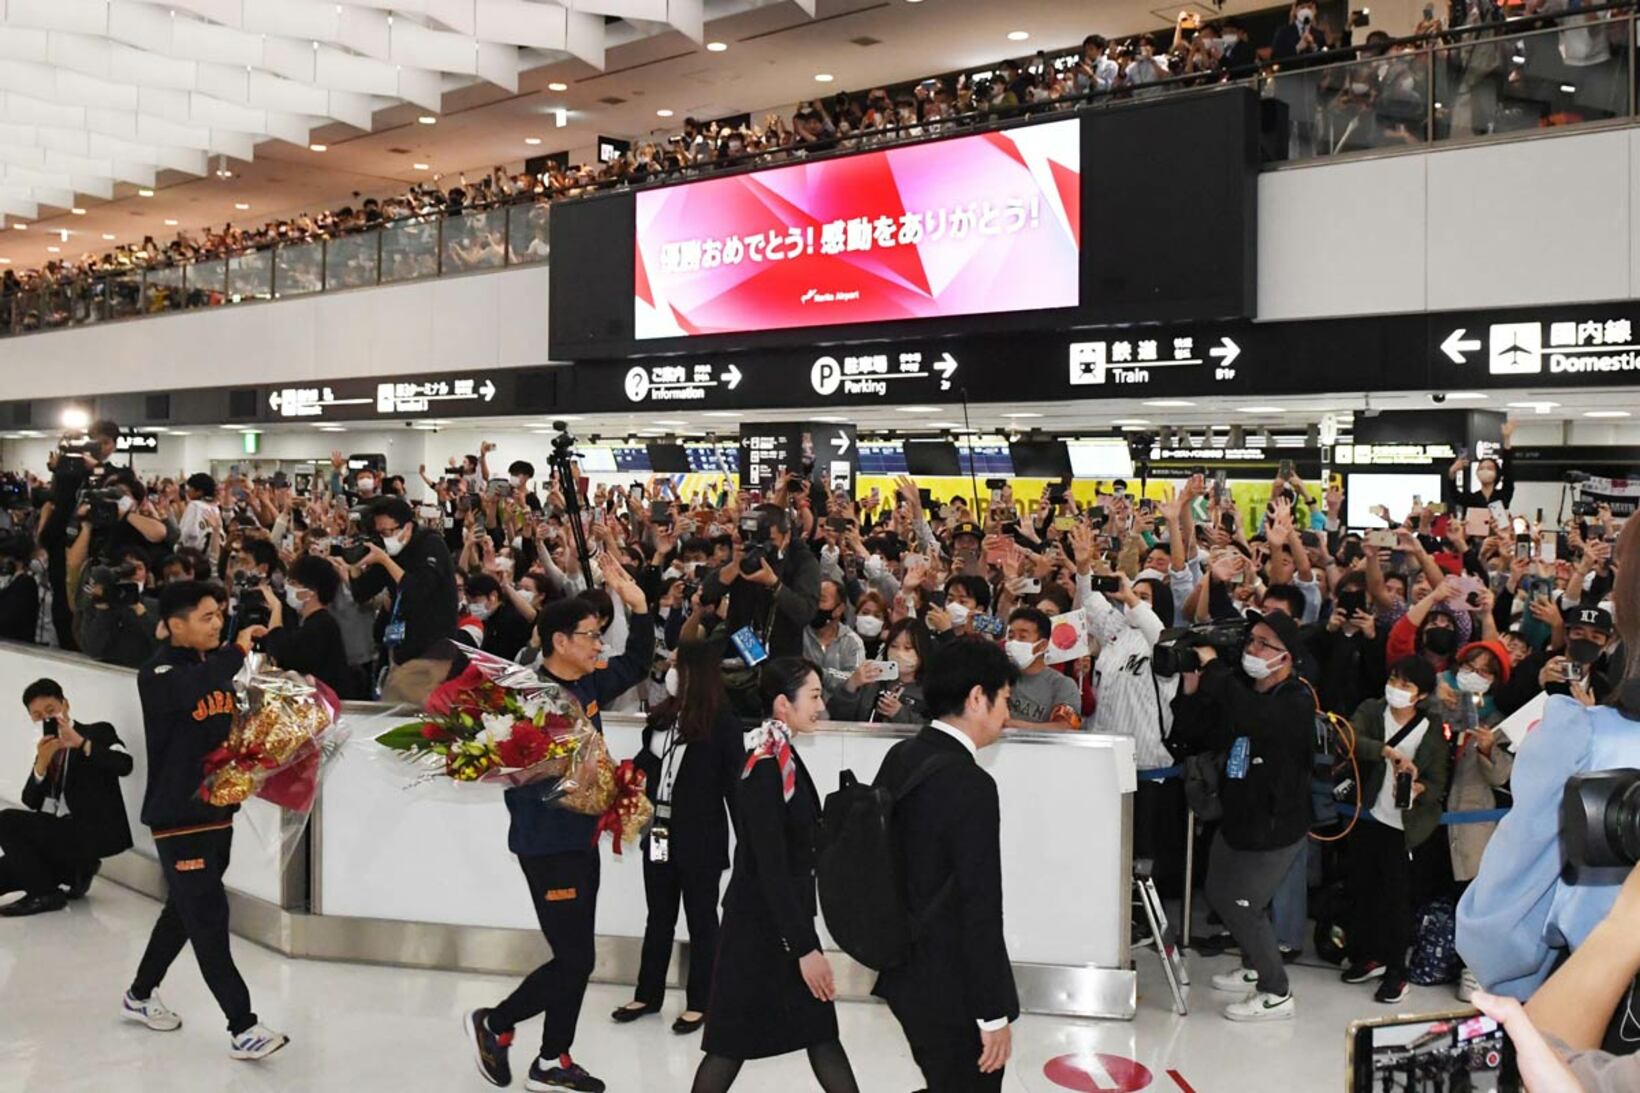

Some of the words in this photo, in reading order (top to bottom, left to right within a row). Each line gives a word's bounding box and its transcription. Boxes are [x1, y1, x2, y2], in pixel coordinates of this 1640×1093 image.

[1550, 319, 1632, 347] 国内線
[1112, 368, 1149, 383] Train
[651, 386, 705, 400] Information
[844, 378, 886, 396] Parking
[192, 690, 237, 721] JAPA
